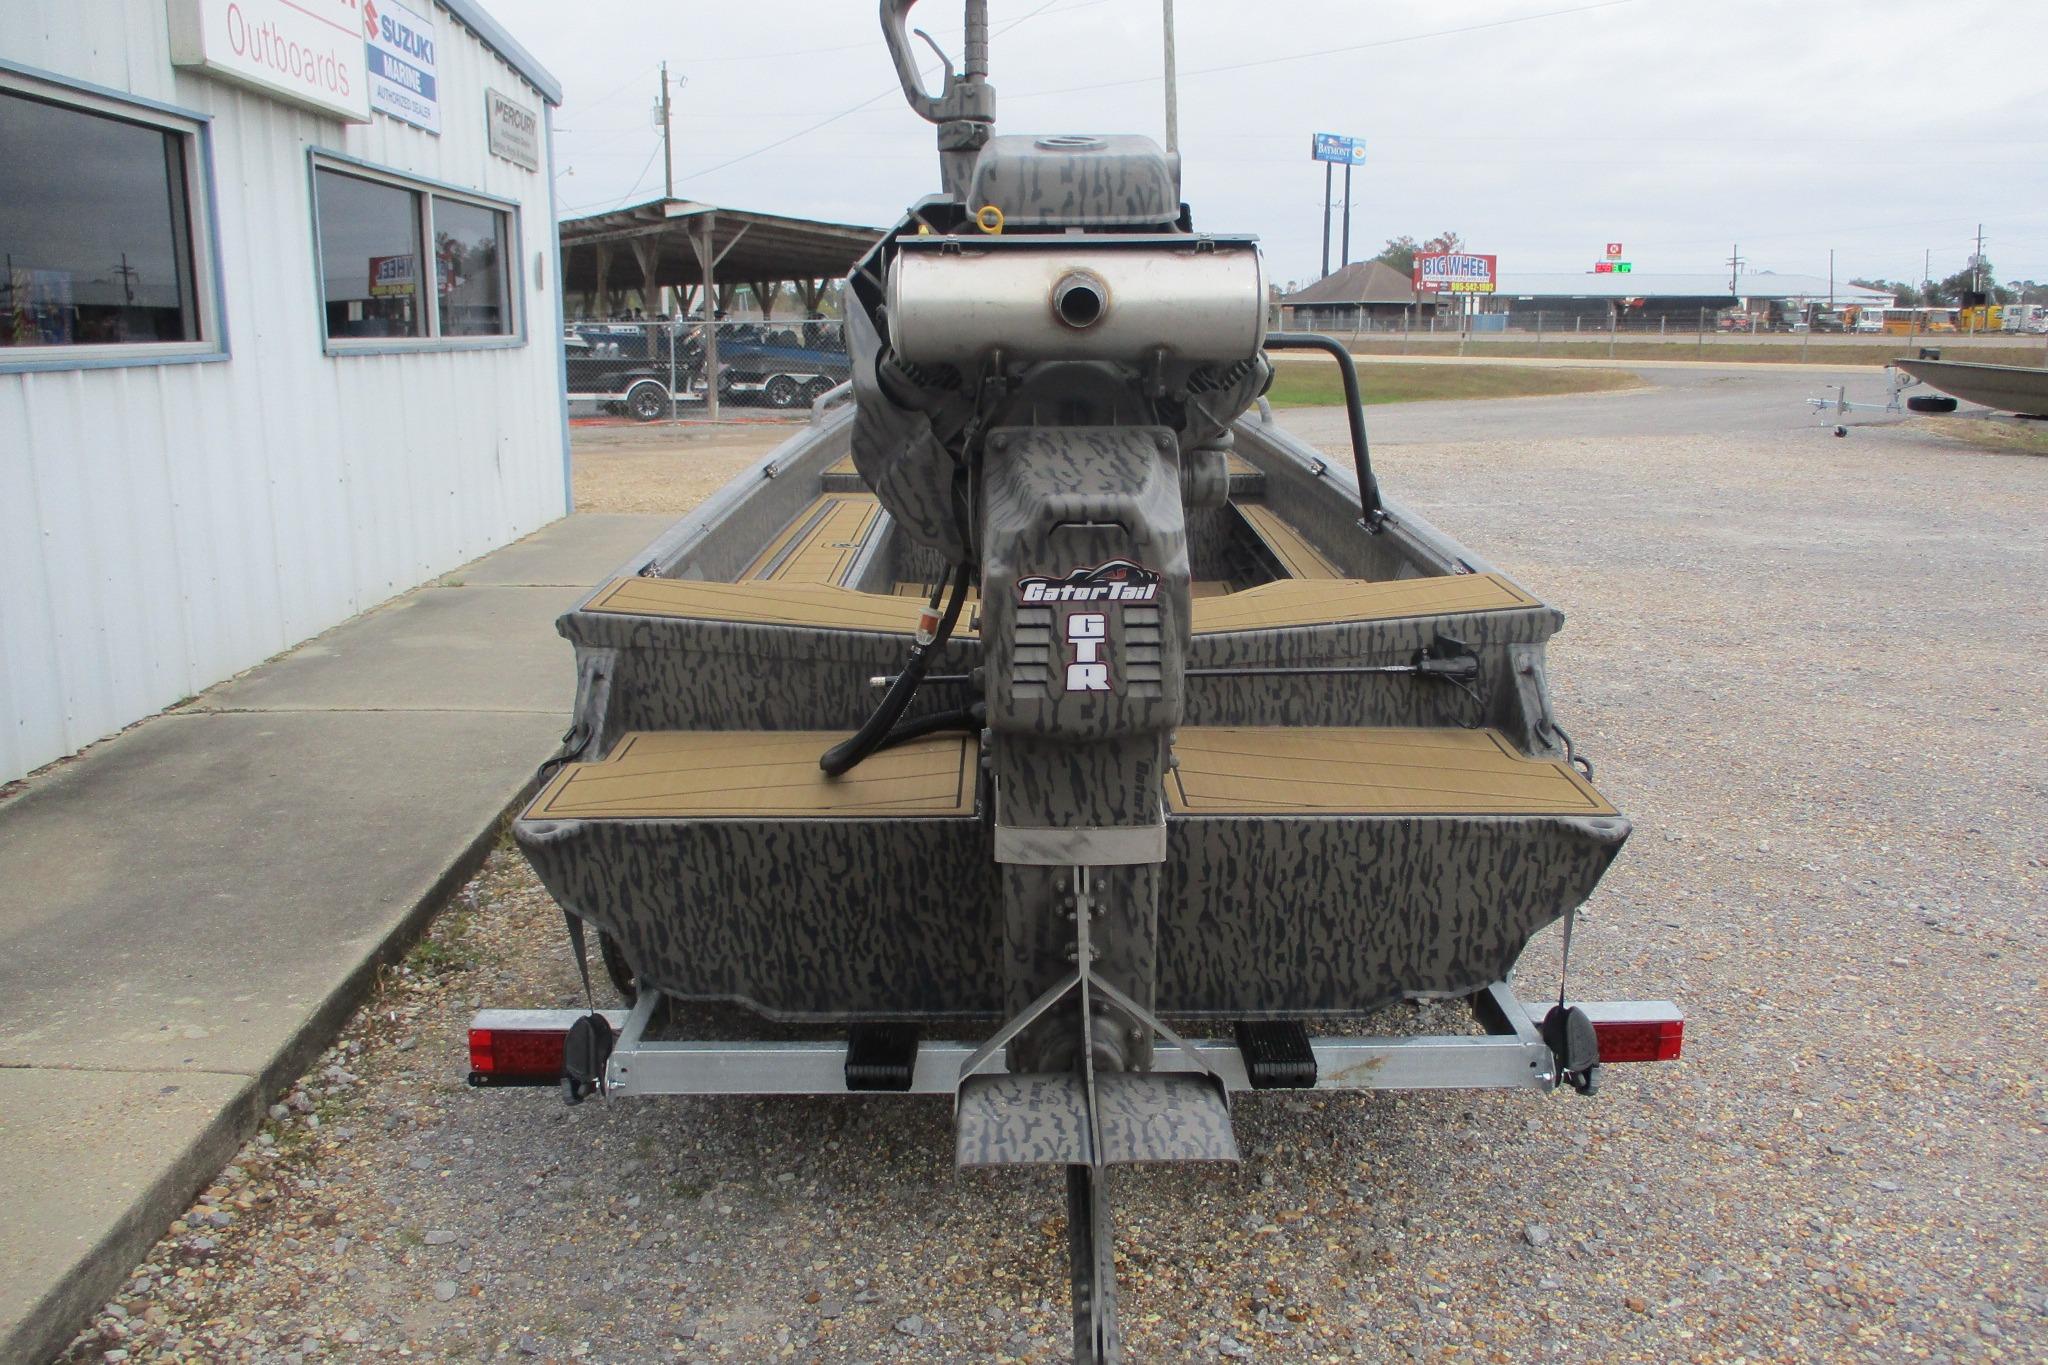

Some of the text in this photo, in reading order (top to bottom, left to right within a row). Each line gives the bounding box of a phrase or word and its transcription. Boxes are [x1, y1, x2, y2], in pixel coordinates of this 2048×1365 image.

[227, 2, 350, 97] Outboards
[382, 14, 434, 65] SUZUKI
[383, 53, 422, 93] MARINE
[495, 98, 536, 137] MERCURY
[1423, 255, 1490, 276] BIG WHEEL
[1022, 581, 1157, 601] GatorTail
[1066, 613, 1112, 691] GTR
